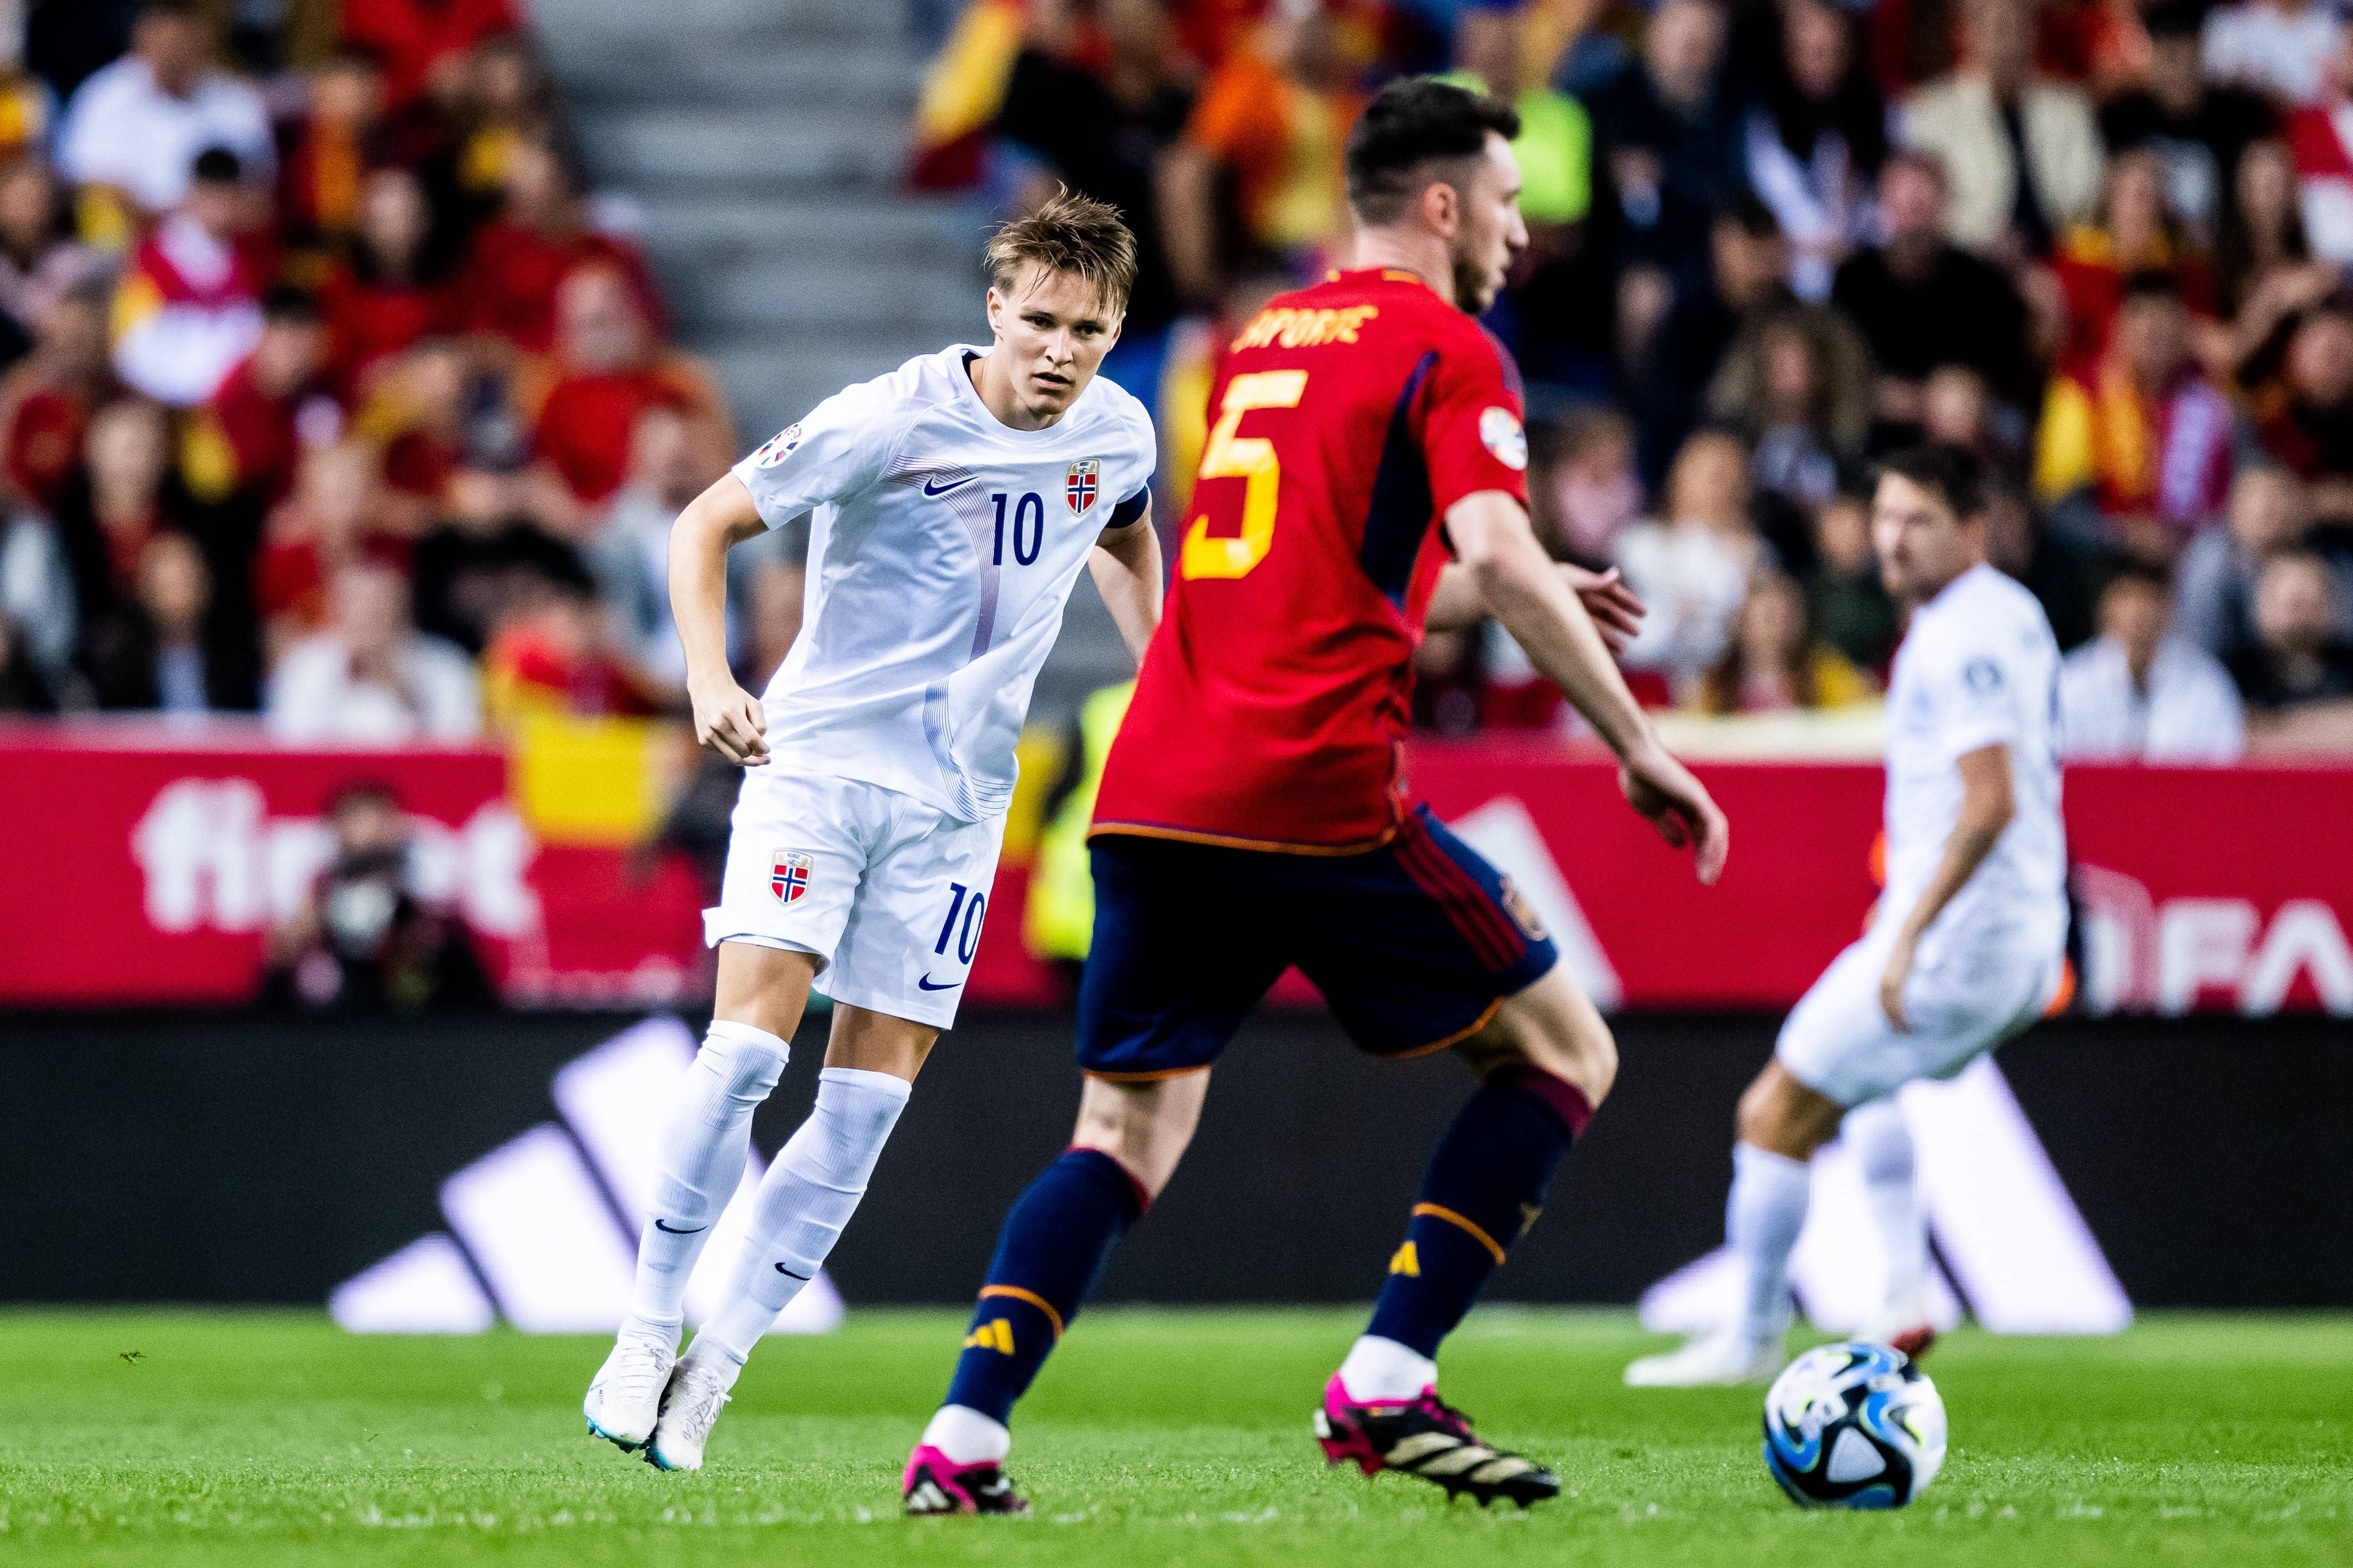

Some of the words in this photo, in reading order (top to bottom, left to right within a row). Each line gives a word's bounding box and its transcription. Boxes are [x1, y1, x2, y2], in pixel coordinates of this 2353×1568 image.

[1182, 370, 1308, 580] 5
[991, 492, 1044, 566] 10
[935, 882, 985, 965] 10
